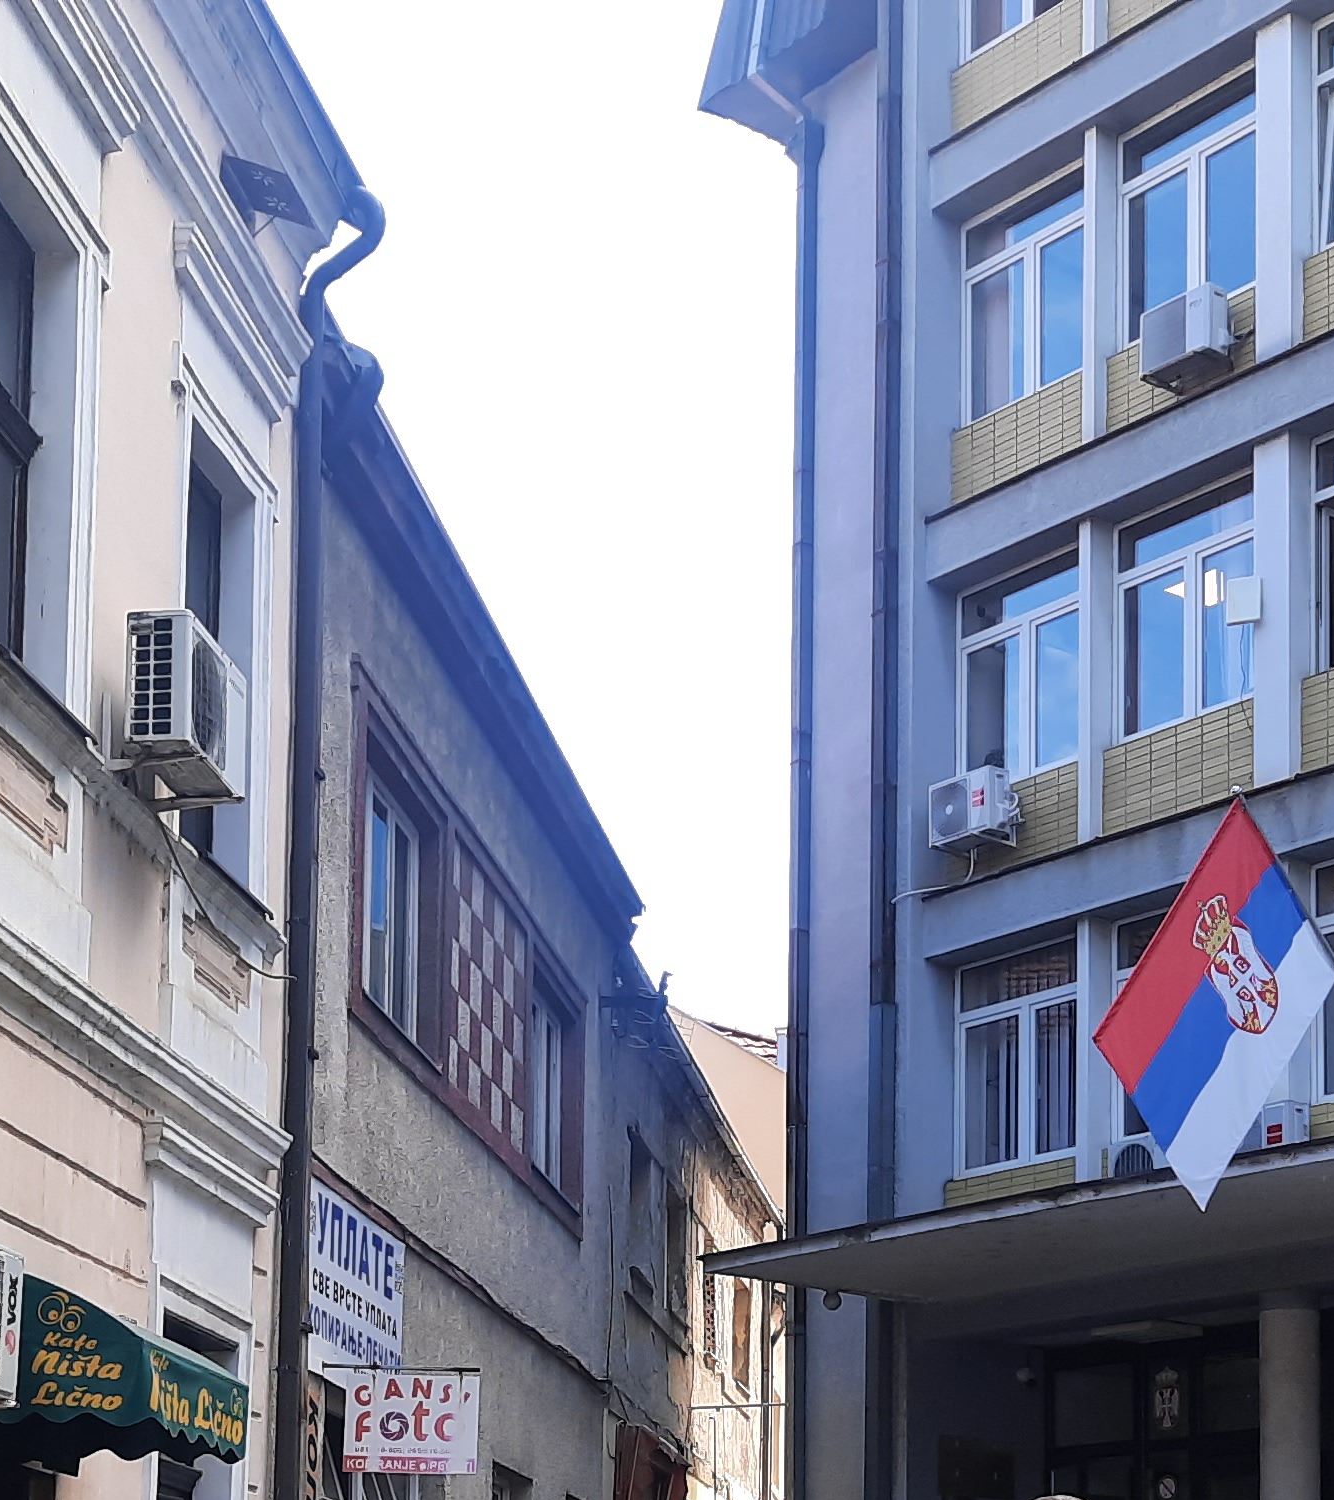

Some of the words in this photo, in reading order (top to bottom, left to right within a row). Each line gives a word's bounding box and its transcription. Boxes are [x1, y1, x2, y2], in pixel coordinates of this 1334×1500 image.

[317, 1191, 395, 1301] УПЛАТЕ
[7, 1273, 18, 1326] VOX
[312, 1268, 330, 1299] СВЕ
[333, 1280, 363, 1319] ВРСТЕ
[365, 1300, 398, 1341] УПЛАТА
[31, 1349, 123, 1380] Ništa
[31, 1382, 123, 1411] Lično
